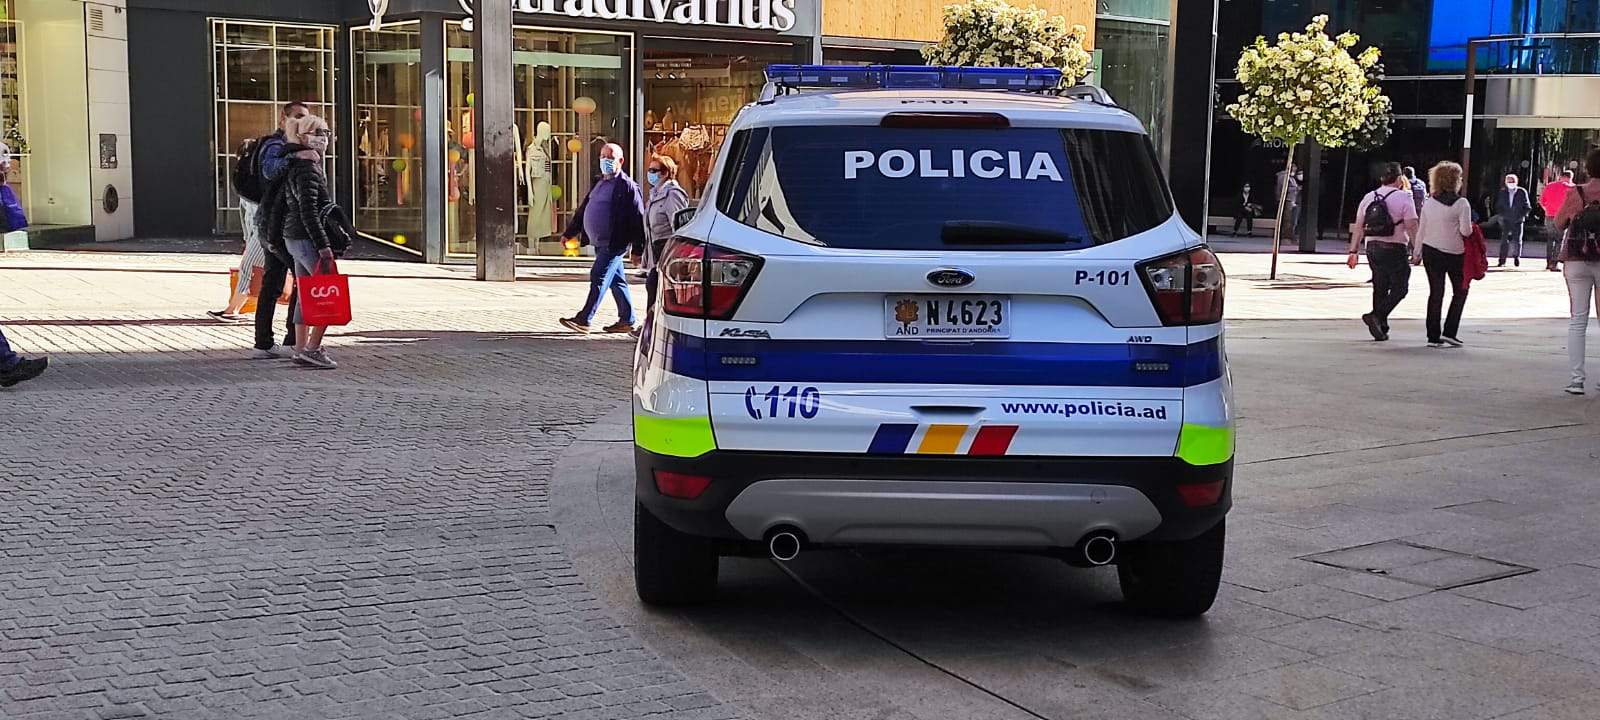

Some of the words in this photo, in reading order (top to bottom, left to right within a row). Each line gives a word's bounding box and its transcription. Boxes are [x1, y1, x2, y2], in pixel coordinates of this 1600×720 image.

[462, 0, 796, 31] adivarius
[844, 149, 1064, 181] POLICIA
[937, 272, 963, 285] Ford
[1075, 270, 1130, 286] P-101
[926, 300, 940, 326] N
[946, 300, 1003, 326] 4623
[896, 326, 919, 335] AND
[764, 385, 820, 419] 110
[1001, 401, 1167, 420] www.policia.ad
